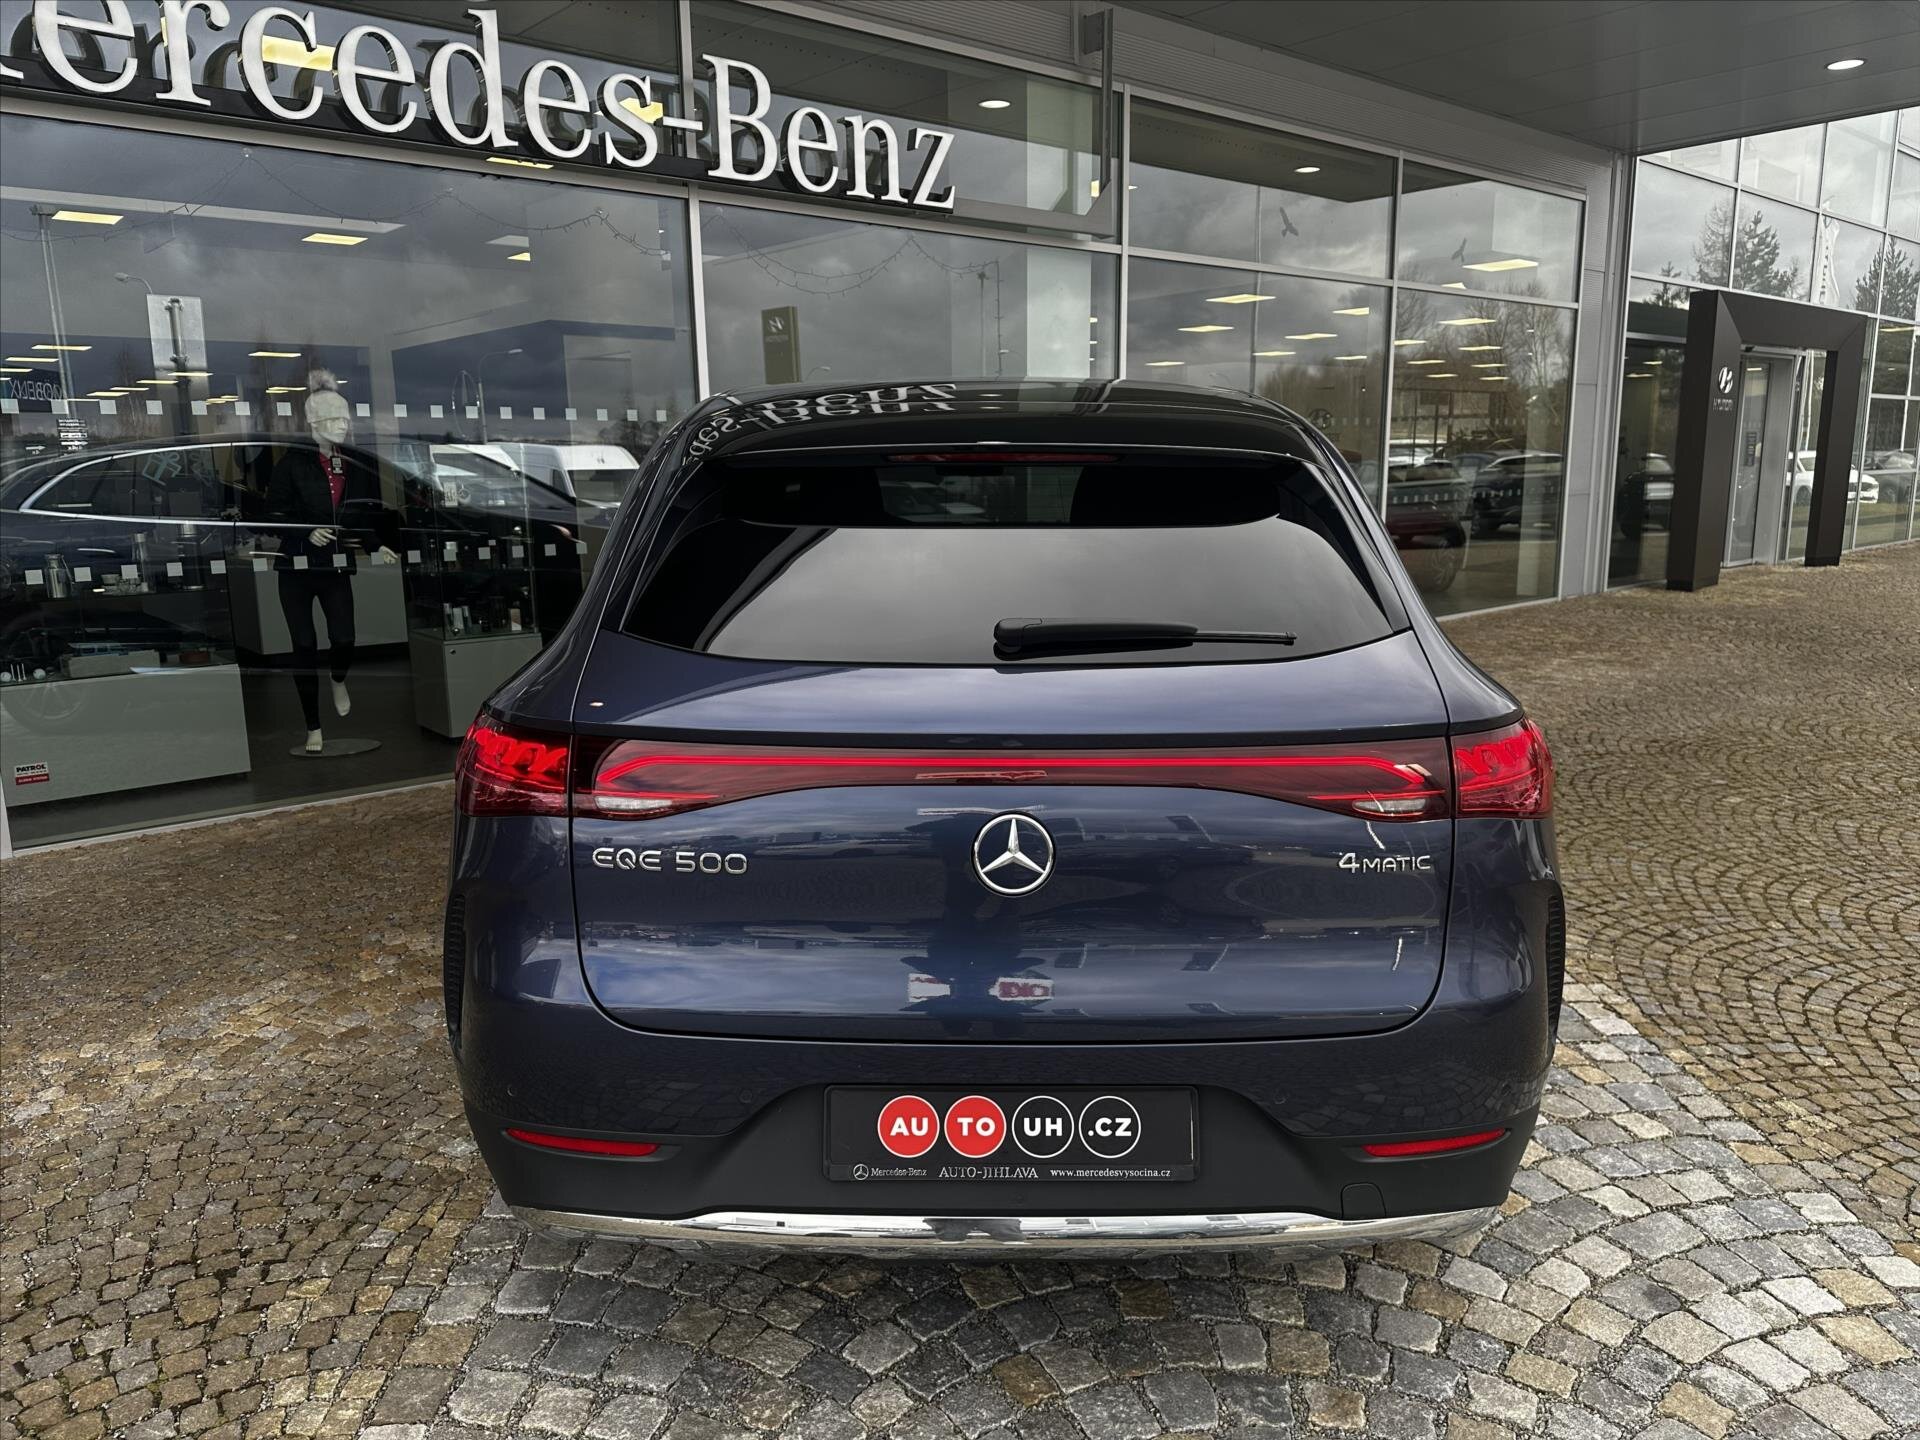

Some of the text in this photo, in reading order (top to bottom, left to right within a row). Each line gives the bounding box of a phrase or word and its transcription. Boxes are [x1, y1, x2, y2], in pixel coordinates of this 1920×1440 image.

[0, 0, 956, 210] ercedes-Benz
[16, 764, 46, 772] PATROL
[592, 847, 748, 875] EQE 500
[1023, 1117, 1063, 1136] UH
[870, 1167, 927, 1177] Mercedes-Benz
[938, 1166, 1039, 1179] AUTO-JIHLAVA
[1050, 1167, 1171, 1179] www.mercedesvysocina.cz
